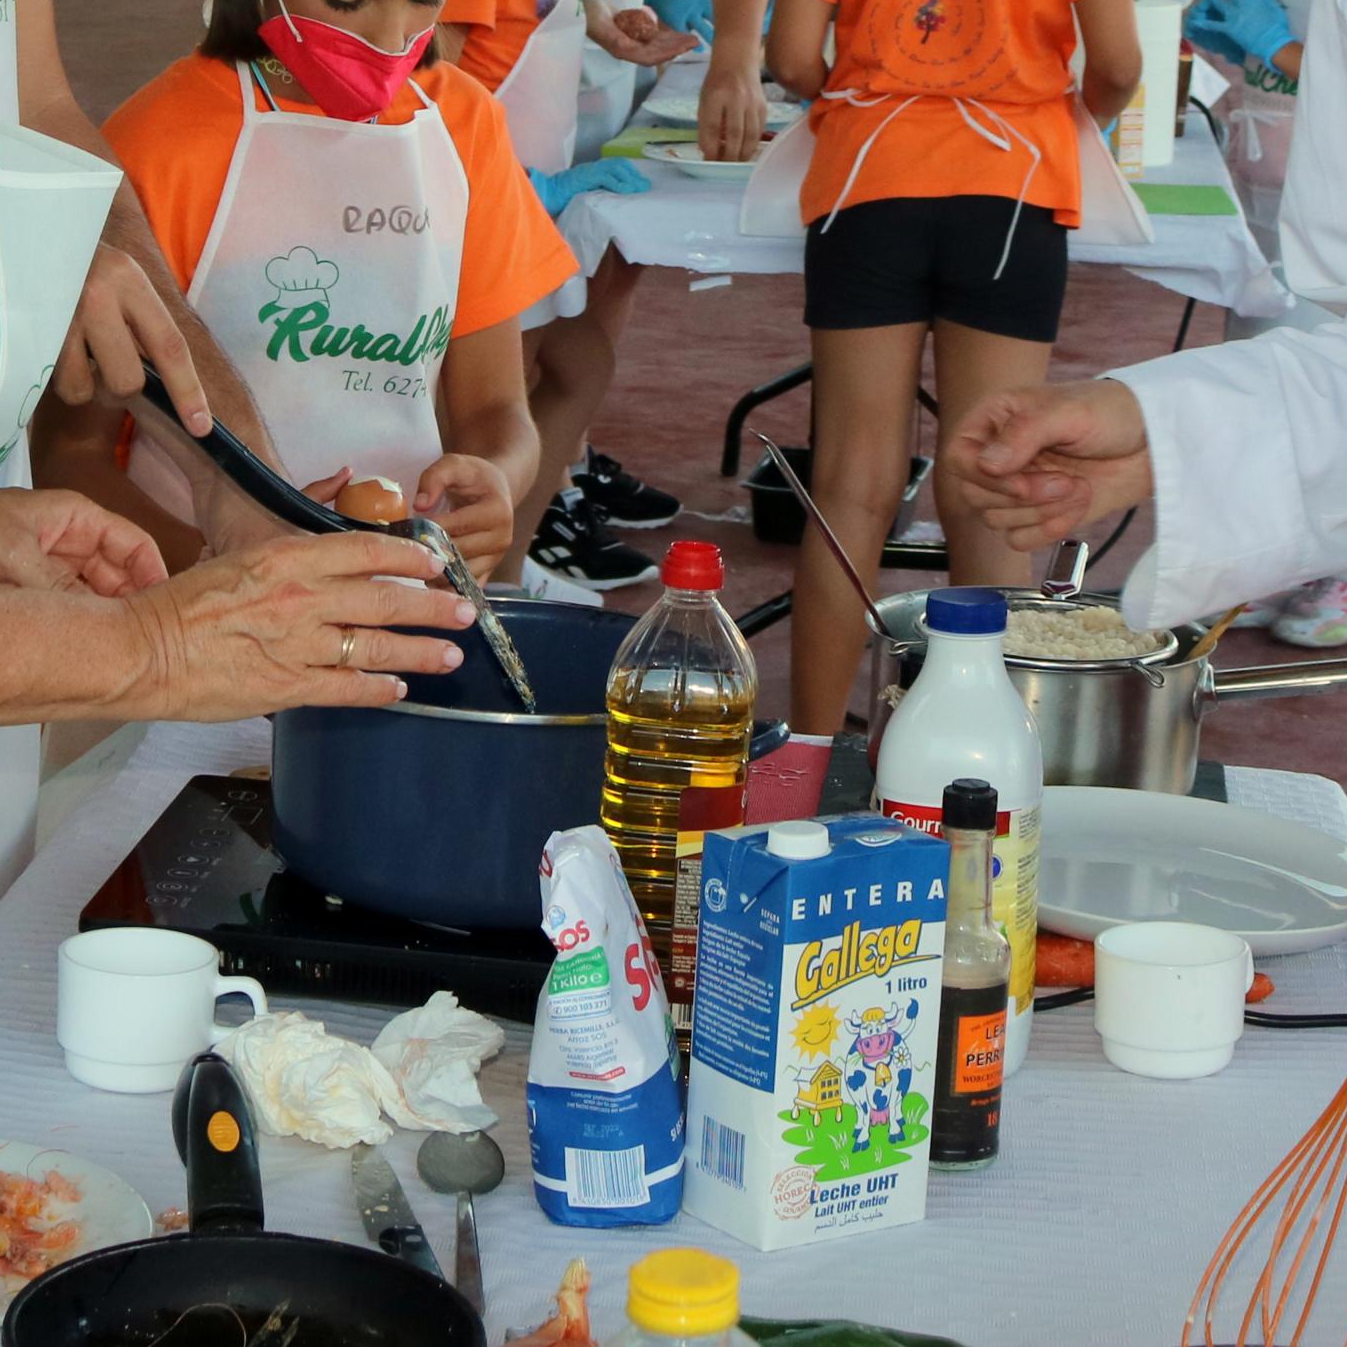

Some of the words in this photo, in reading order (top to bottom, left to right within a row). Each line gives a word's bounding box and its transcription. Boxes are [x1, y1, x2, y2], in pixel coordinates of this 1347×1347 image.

[342, 370, 373, 393] Tel.
[791, 879, 945, 921] ENTERA
[794, 916, 924, 999] Gallega
[885, 981, 893, 995] 1
[898, 976, 928, 992] litro
[809, 1181, 862, 1205] Leche
[866, 1172, 900, 1193] UHT
[814, 1203, 835, 1219] Lait
[836, 1200, 856, 1214] UHT
[858, 1194, 890, 1209] entier
